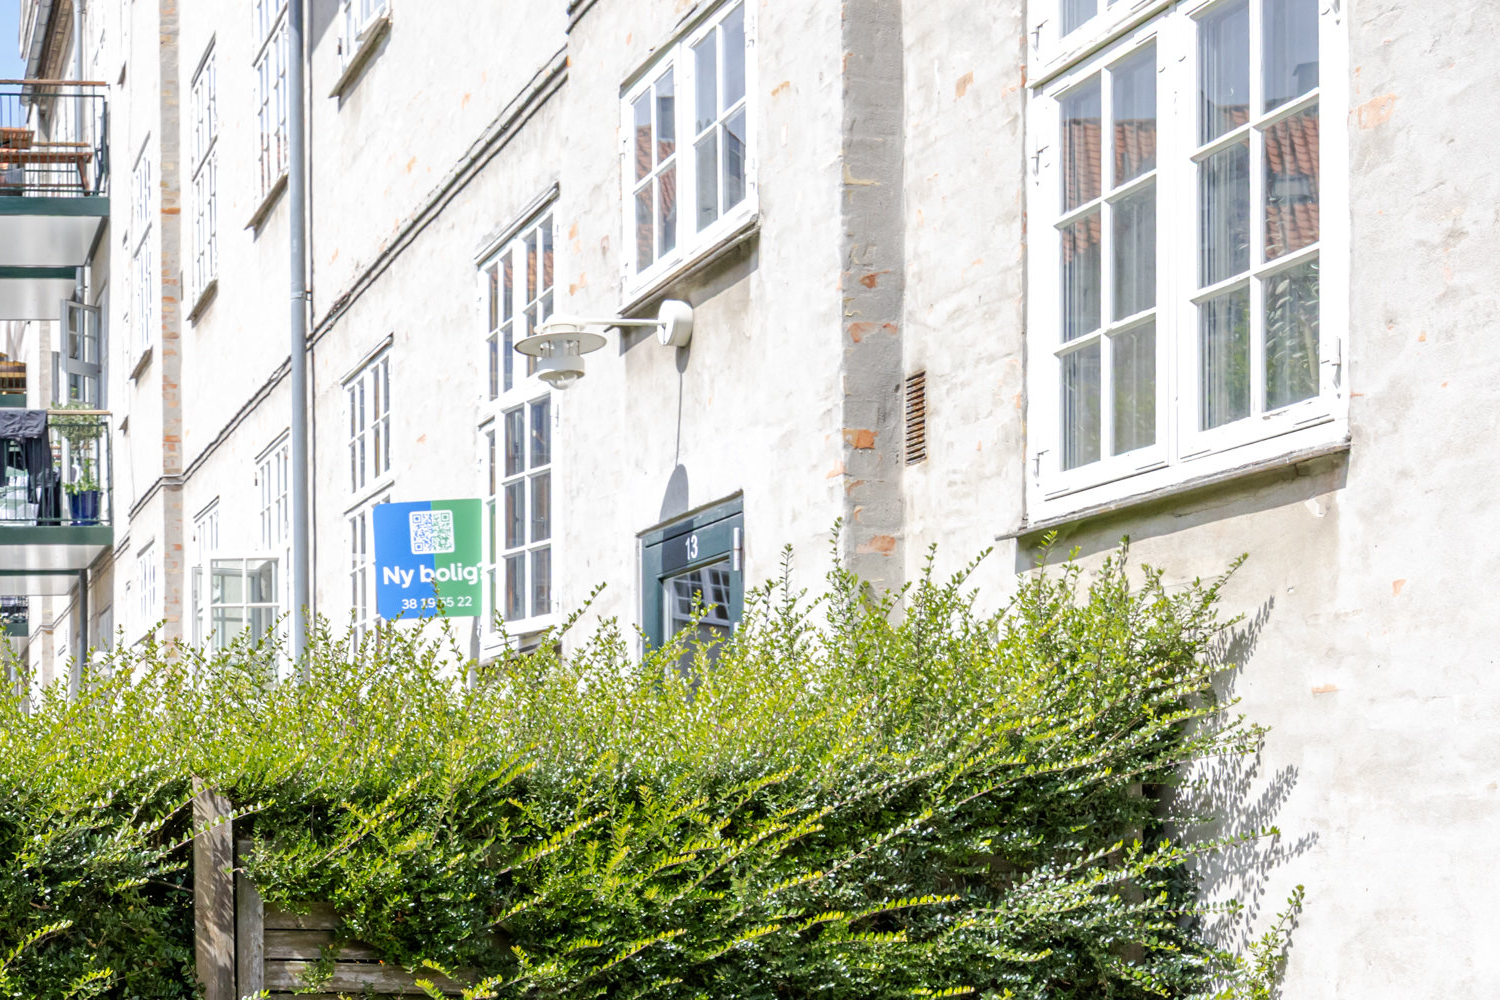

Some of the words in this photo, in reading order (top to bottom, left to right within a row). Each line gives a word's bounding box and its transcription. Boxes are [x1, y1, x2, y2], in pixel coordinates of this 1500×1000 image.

[685, 534, 698, 560] 13
[382, 566, 415, 588] Ny
[401, 598, 418, 610] 38
[420, 597, 436, 609] 19
[457, 595, 473, 607] 22
